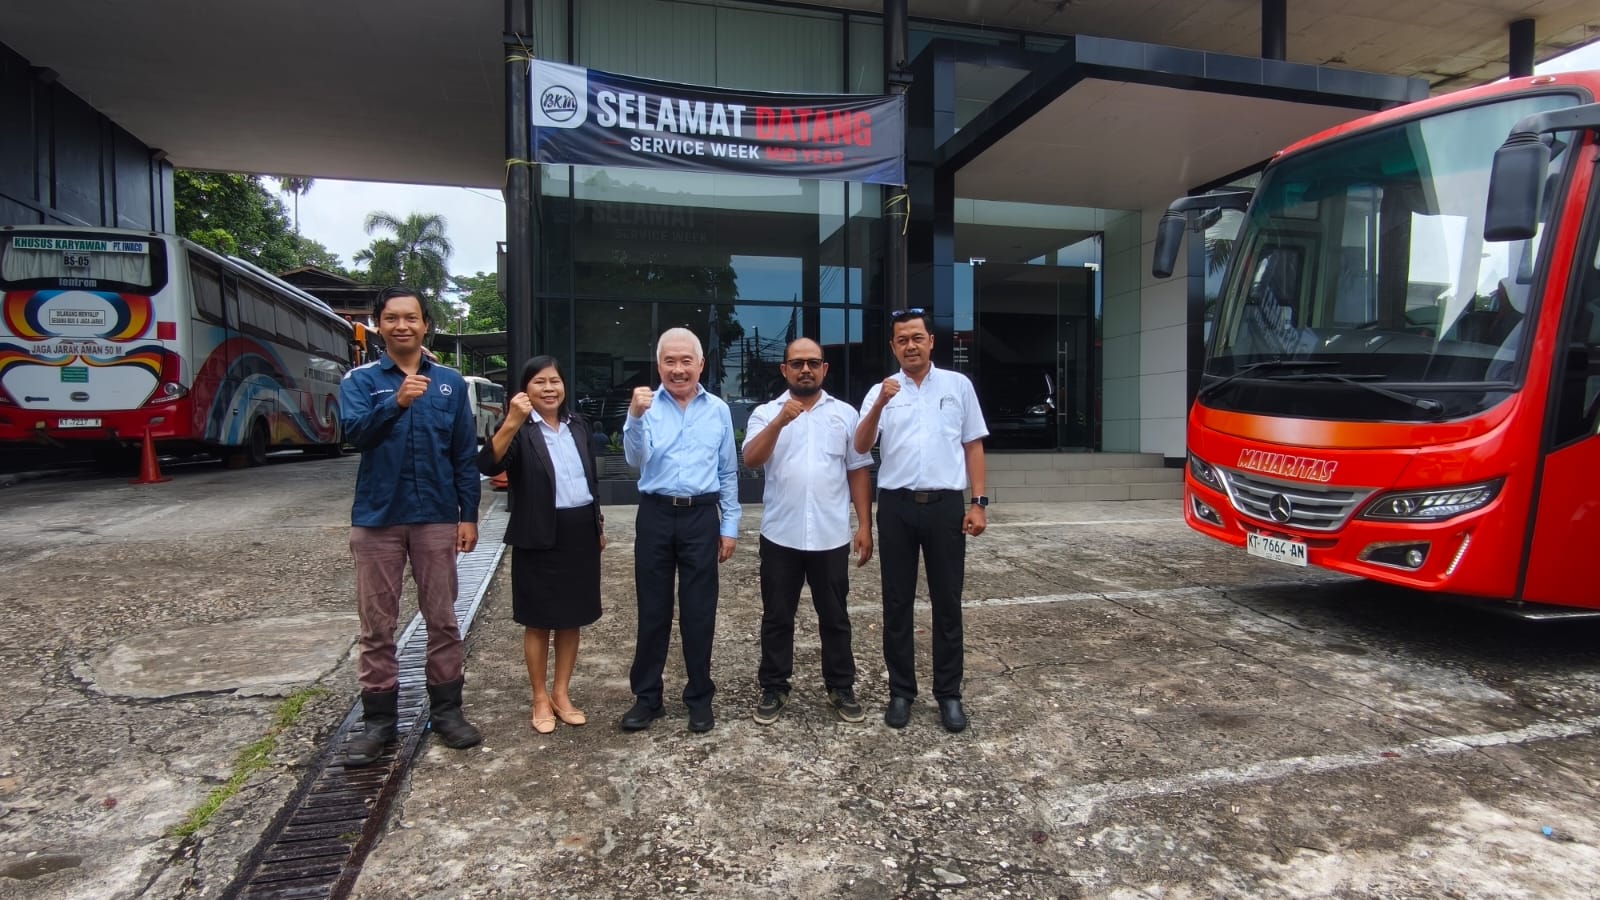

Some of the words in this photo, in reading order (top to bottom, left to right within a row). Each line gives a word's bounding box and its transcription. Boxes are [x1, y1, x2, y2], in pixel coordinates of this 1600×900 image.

[596, 90, 746, 137] SELAMAT
[755, 106, 872, 147] DATANG
[630, 136, 705, 156] SERVICE
[711, 142, 760, 160] WEEK
[766, 146, 797, 162] MID
[802, 149, 844, 165] YEAR
[14, 238, 53, 249] KHUSUS
[55, 239, 107, 251] KARYAWAN
[63, 256, 89, 266] BS-05
[32, 345, 52, 354] JAGA
[53, 345, 79, 354] JARAK
[80, 346, 103, 354] AMAN
[104, 346, 114, 355] 50
[115, 346, 122, 355] M
[1237, 448, 1338, 481] MAHARITAS
